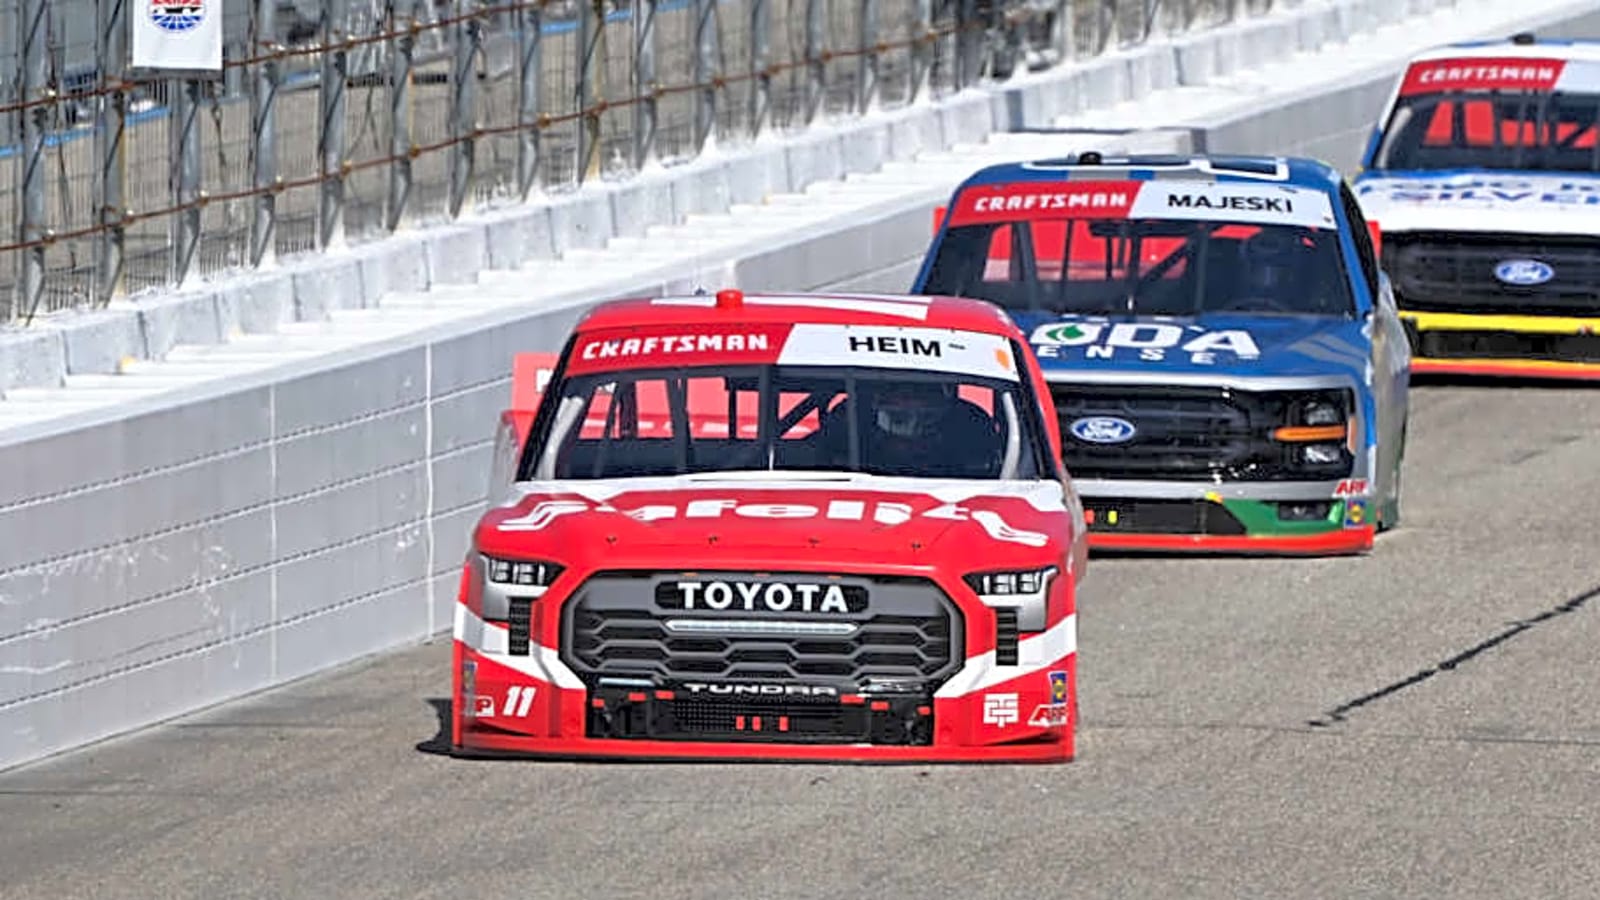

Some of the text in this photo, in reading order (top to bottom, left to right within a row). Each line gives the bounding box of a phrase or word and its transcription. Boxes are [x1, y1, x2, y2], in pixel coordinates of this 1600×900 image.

[1419, 65, 1555, 83] CRAFTSMAN
[974, 192, 1127, 212] CRAFTSMAN
[1167, 193, 1293, 213] MAJESKI
[582, 333, 767, 360] CRAFTSMAN
[848, 336, 942, 358] HEIM
[1029, 321, 1261, 361] ODA
[1036, 344, 1216, 365] ENSE
[677, 582, 849, 613] TOYOTA
[683, 683, 838, 696] TUNDRA
[502, 685, 537, 718] 11
